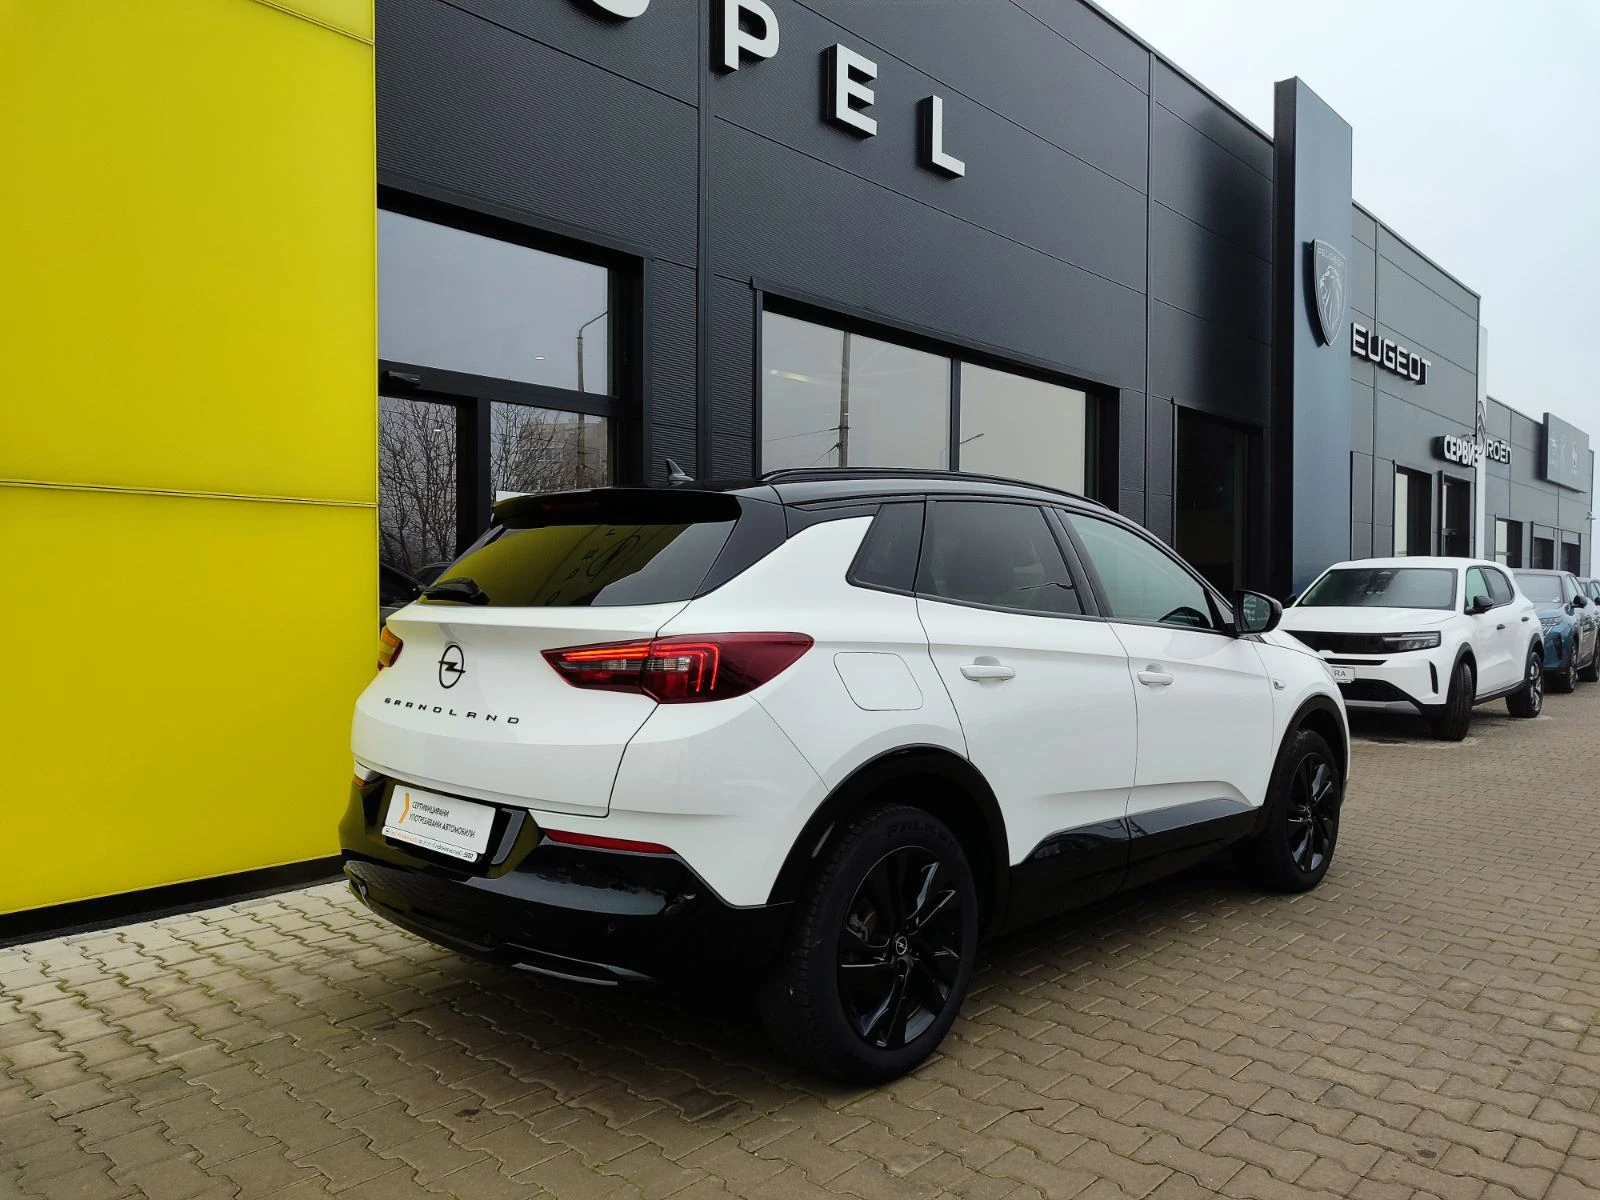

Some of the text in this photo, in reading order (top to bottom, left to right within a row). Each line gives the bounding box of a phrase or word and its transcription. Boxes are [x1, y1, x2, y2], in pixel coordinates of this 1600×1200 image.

[588, 0, 965, 178] PEL
[1352, 322, 1432, 385] EUGEOT
[1486, 439, 1512, 465] ROËN
[384, 697, 520, 725] GRANDLAND
[441, 823, 475, 839] АВТОМОБИЛИ
